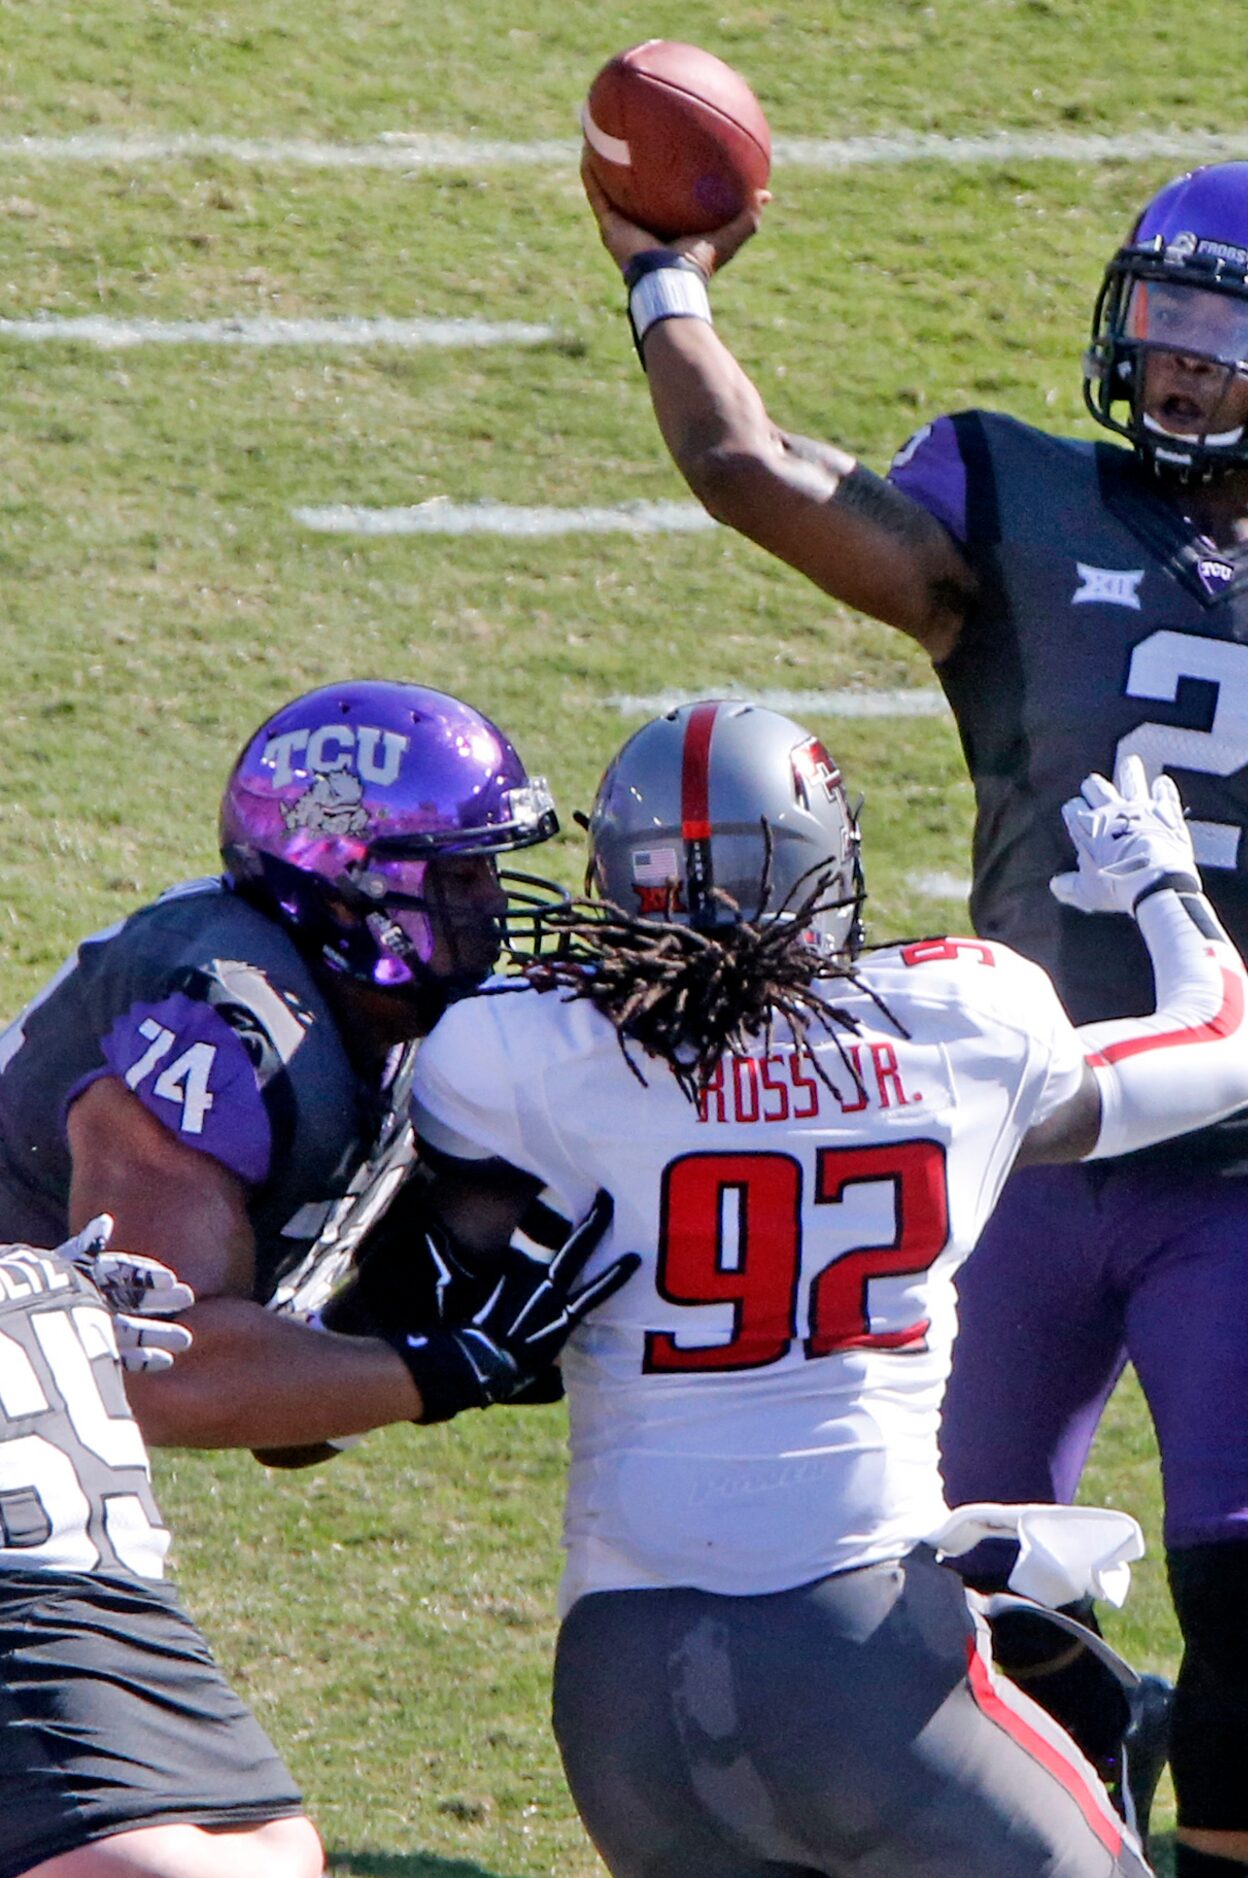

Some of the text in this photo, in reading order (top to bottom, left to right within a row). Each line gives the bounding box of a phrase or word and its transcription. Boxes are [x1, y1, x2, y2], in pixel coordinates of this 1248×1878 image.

[1200, 561, 1233, 582] TCU
[261, 724, 408, 788] TCU
[125, 1017, 216, 1134] 74
[697, 1042, 922, 1123] ROSS JR.
[642, 1138, 950, 1375] 92
